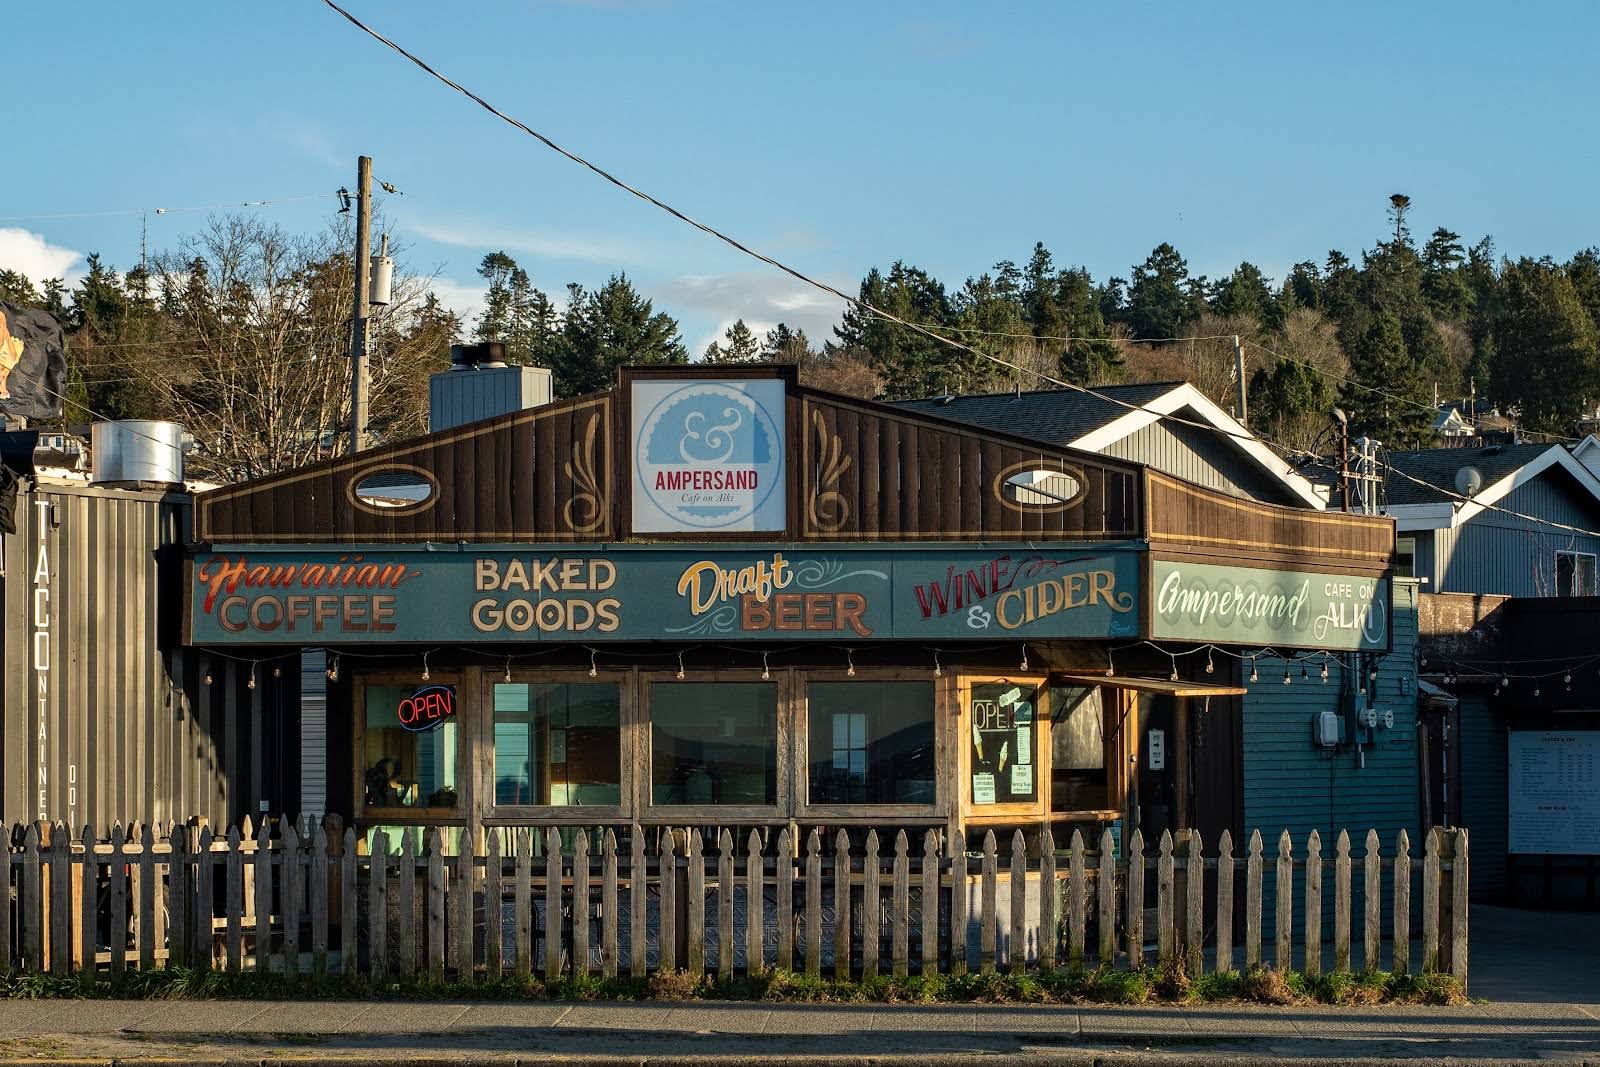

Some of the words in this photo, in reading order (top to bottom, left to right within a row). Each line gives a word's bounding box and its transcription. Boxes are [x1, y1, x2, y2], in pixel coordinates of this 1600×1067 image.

[655, 470, 758, 490] AMPERSAND
[681, 493, 701, 504] Cafe
[703, 495, 713, 503] on
[716, 493, 734, 502] Alki
[199, 554, 422, 614] Hawaiian
[474, 557, 618, 592] BAKED
[677, 552, 794, 616] Draft
[913, 554, 1035, 620] WINE
[1324, 582, 1352, 600] CAFE
[1359, 584, 1375, 600] ON
[217, 595, 398, 634] COFFEE
[470, 598, 621, 633] GOODS
[740, 593, 873, 638] BEER
[966, 604, 992, 630] &
[994, 567, 1134, 631] CIDER
[1157, 570, 1310, 626] Ampersand
[1314, 601, 1380, 640] ALKI
[398, 691, 452, 723] OPEN
